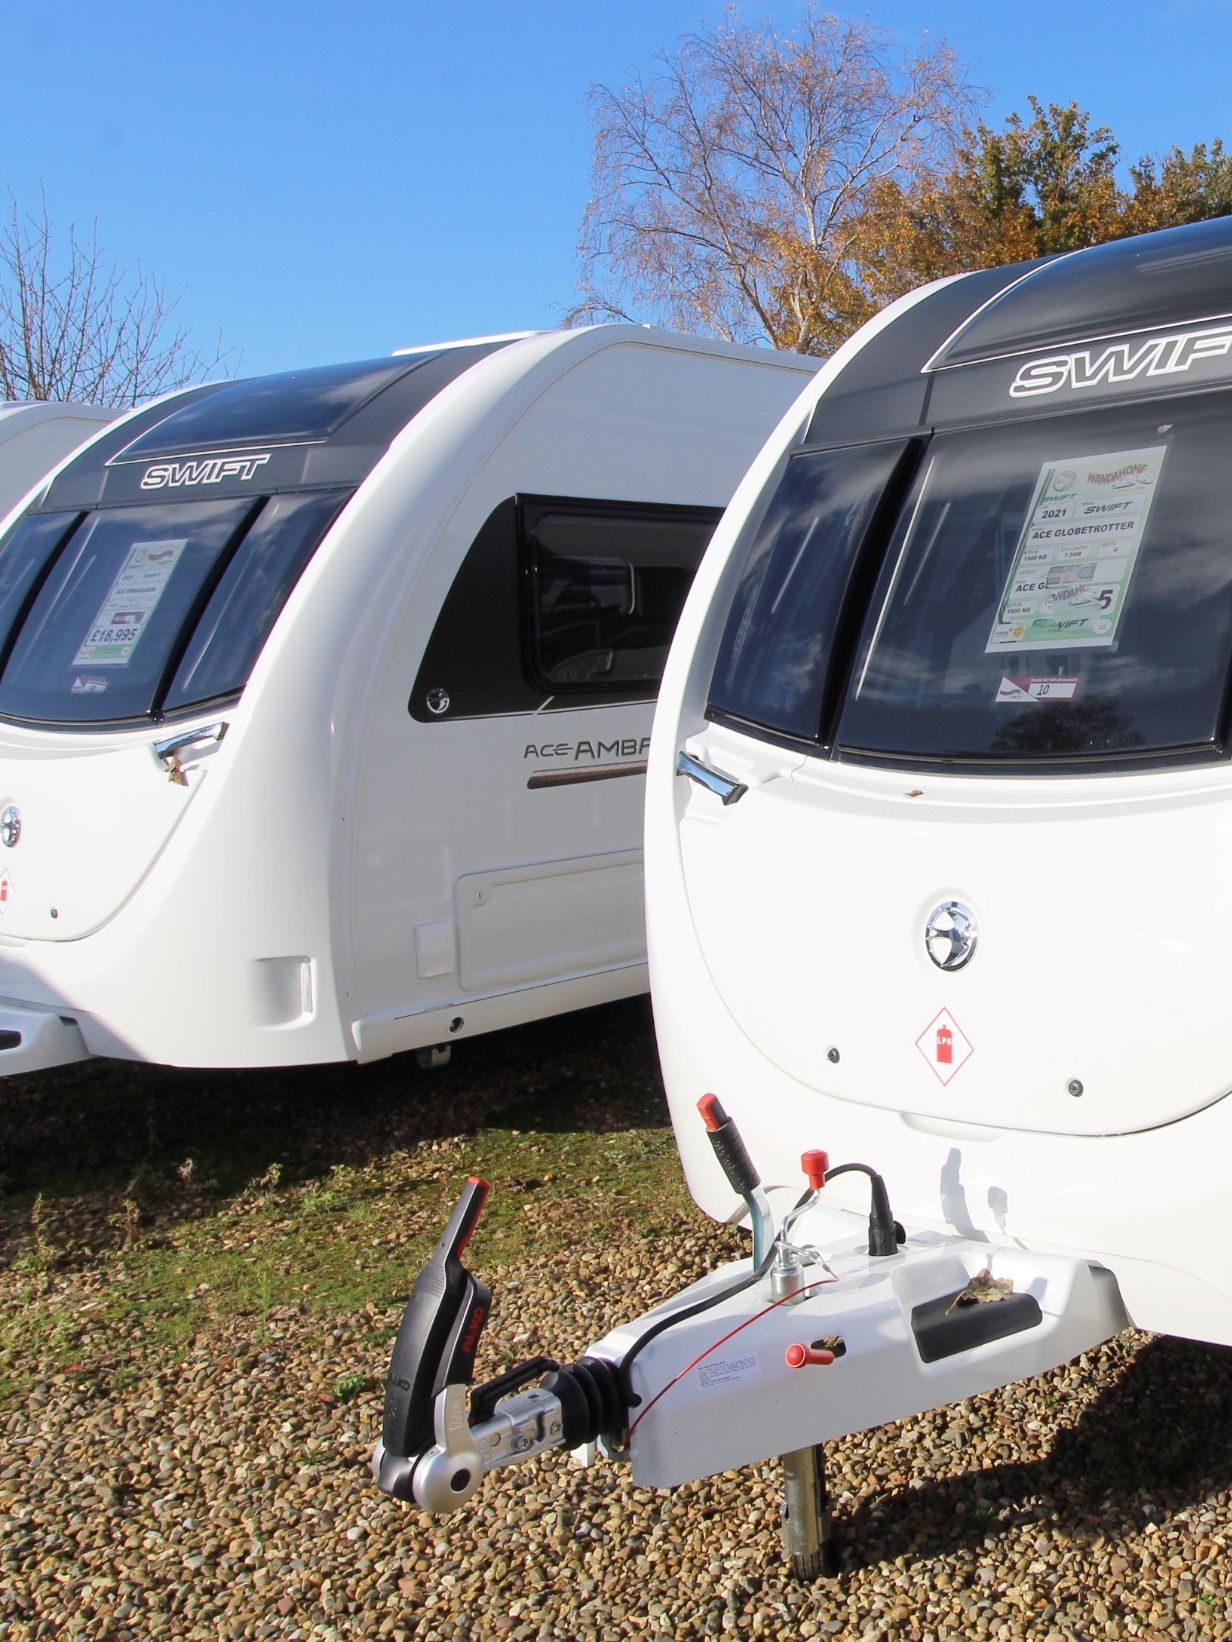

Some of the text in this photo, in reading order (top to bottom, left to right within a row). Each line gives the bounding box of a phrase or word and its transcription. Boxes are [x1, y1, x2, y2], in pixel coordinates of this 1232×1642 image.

[140, 453, 272, 490] SWIFT
[1041, 501, 1134, 519] 2021 SWIFT
[1032, 521, 1135, 540] ACE GLOBETROTTER
[1015, 583, 1036, 592] ACE
[1099, 589, 1114, 610] 5
[90, 628, 138, 644] £18,995
[1036, 684, 1050, 696] 10
[524, 743, 574, 759] ACE
[937, 1036, 952, 1045] LPG
